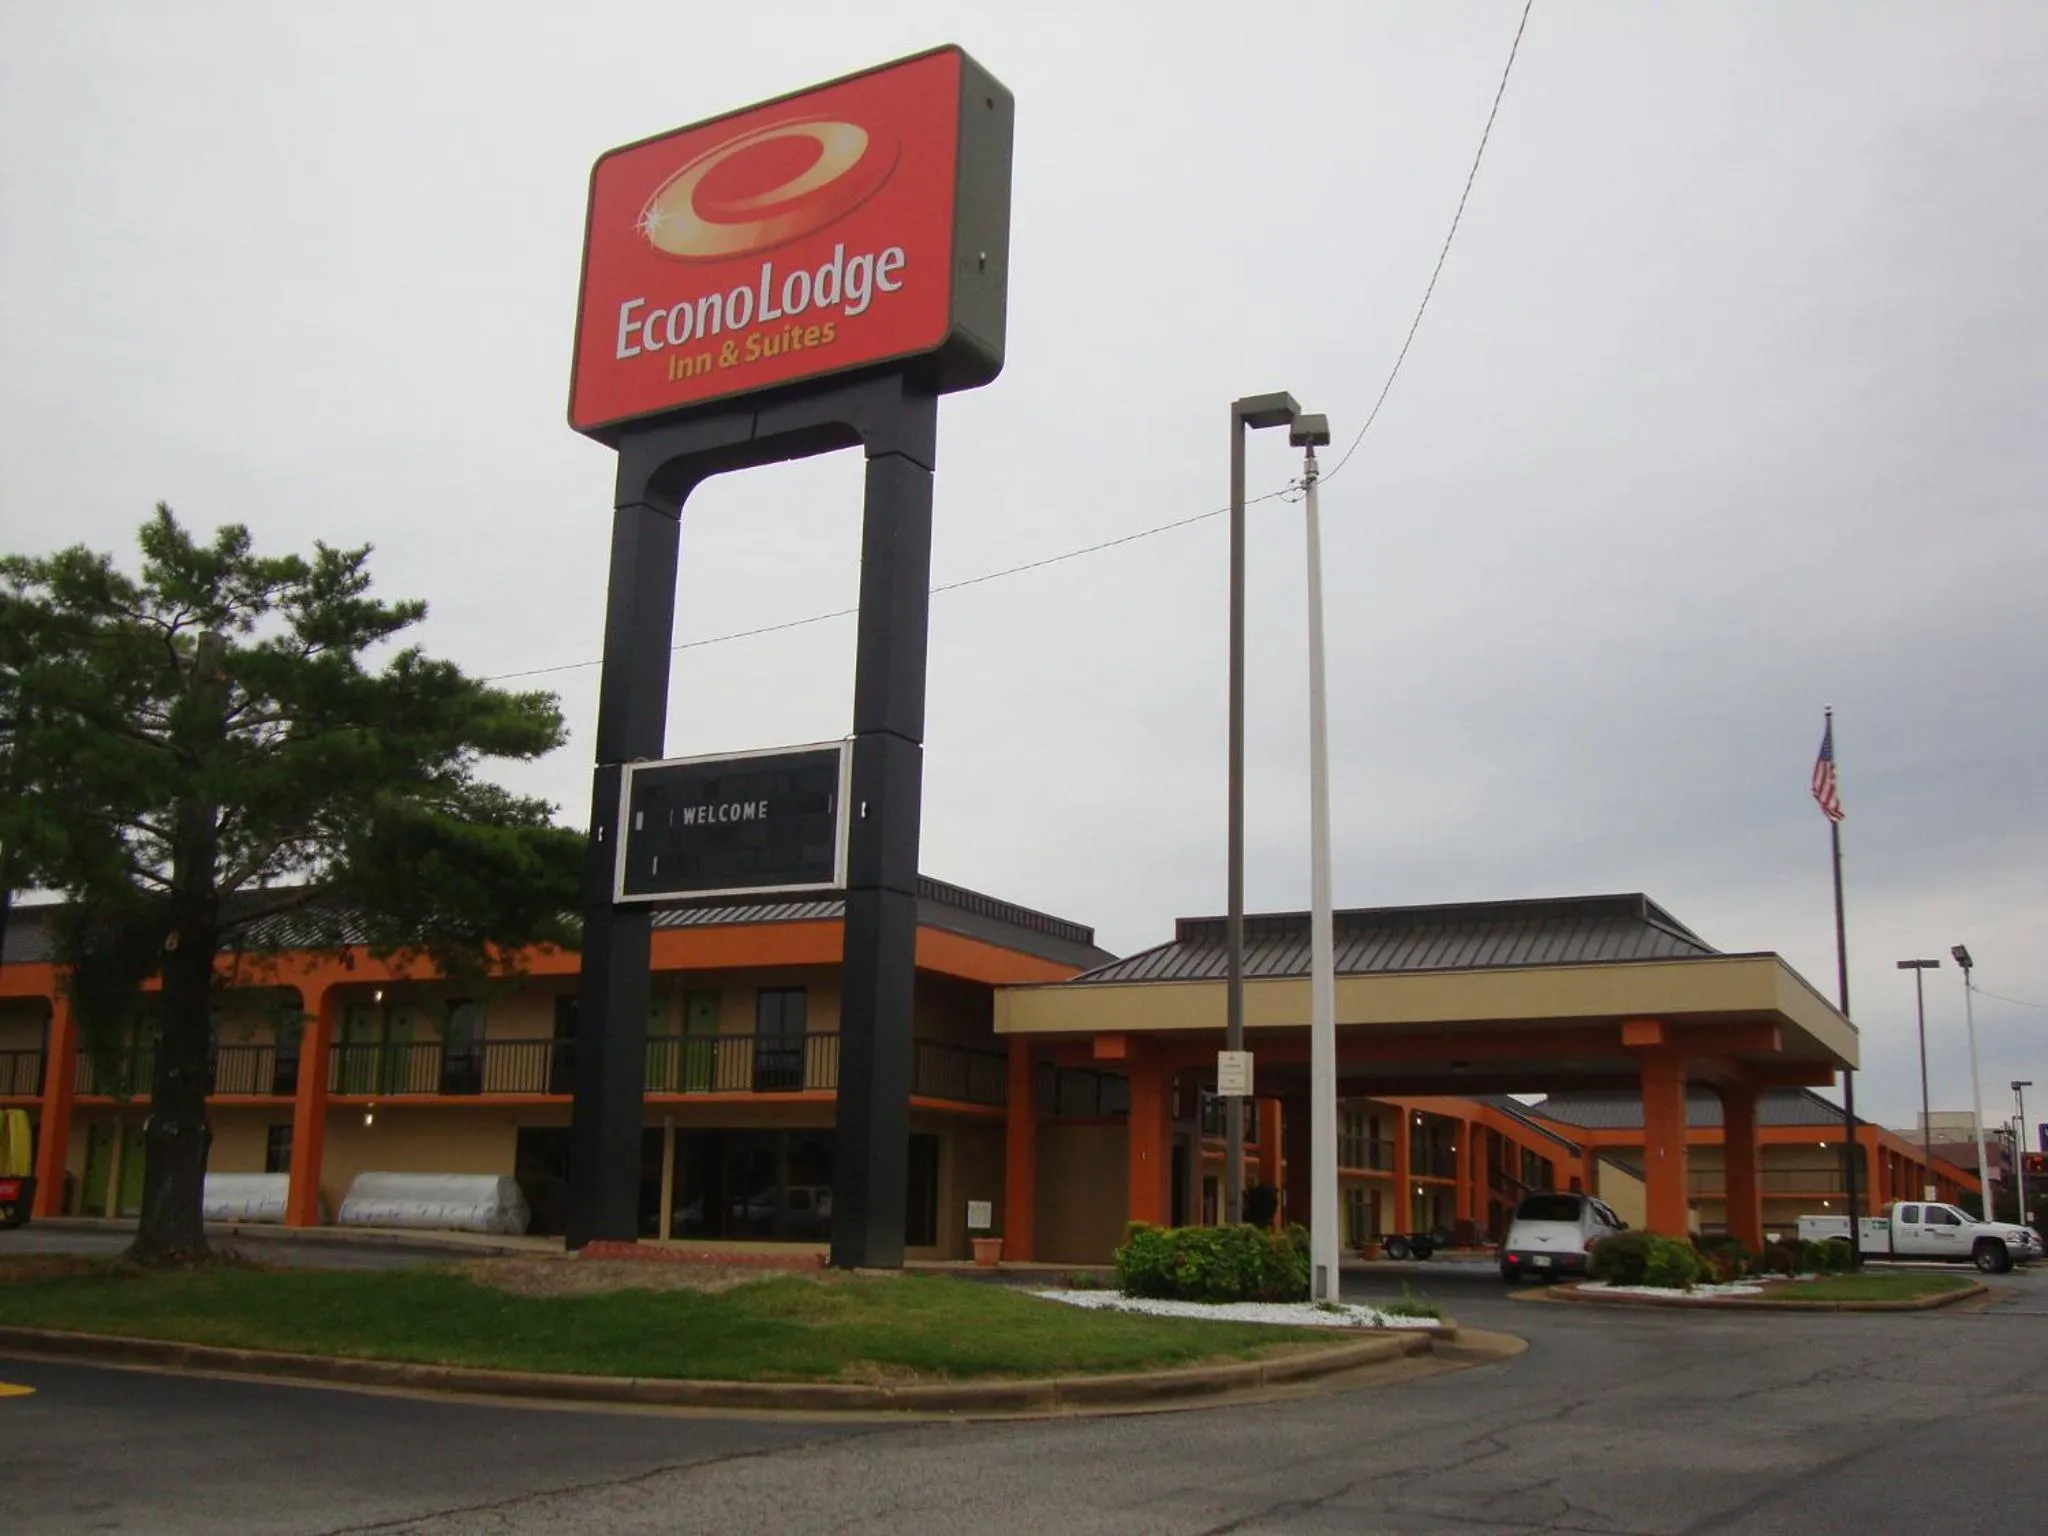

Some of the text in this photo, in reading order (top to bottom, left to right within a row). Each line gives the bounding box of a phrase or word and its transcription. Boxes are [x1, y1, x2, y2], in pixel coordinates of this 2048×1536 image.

[616, 244, 905, 359] EconoLodge
[668, 322, 837, 382] Inn & Suites
[683, 801, 769, 825] WELCOME
